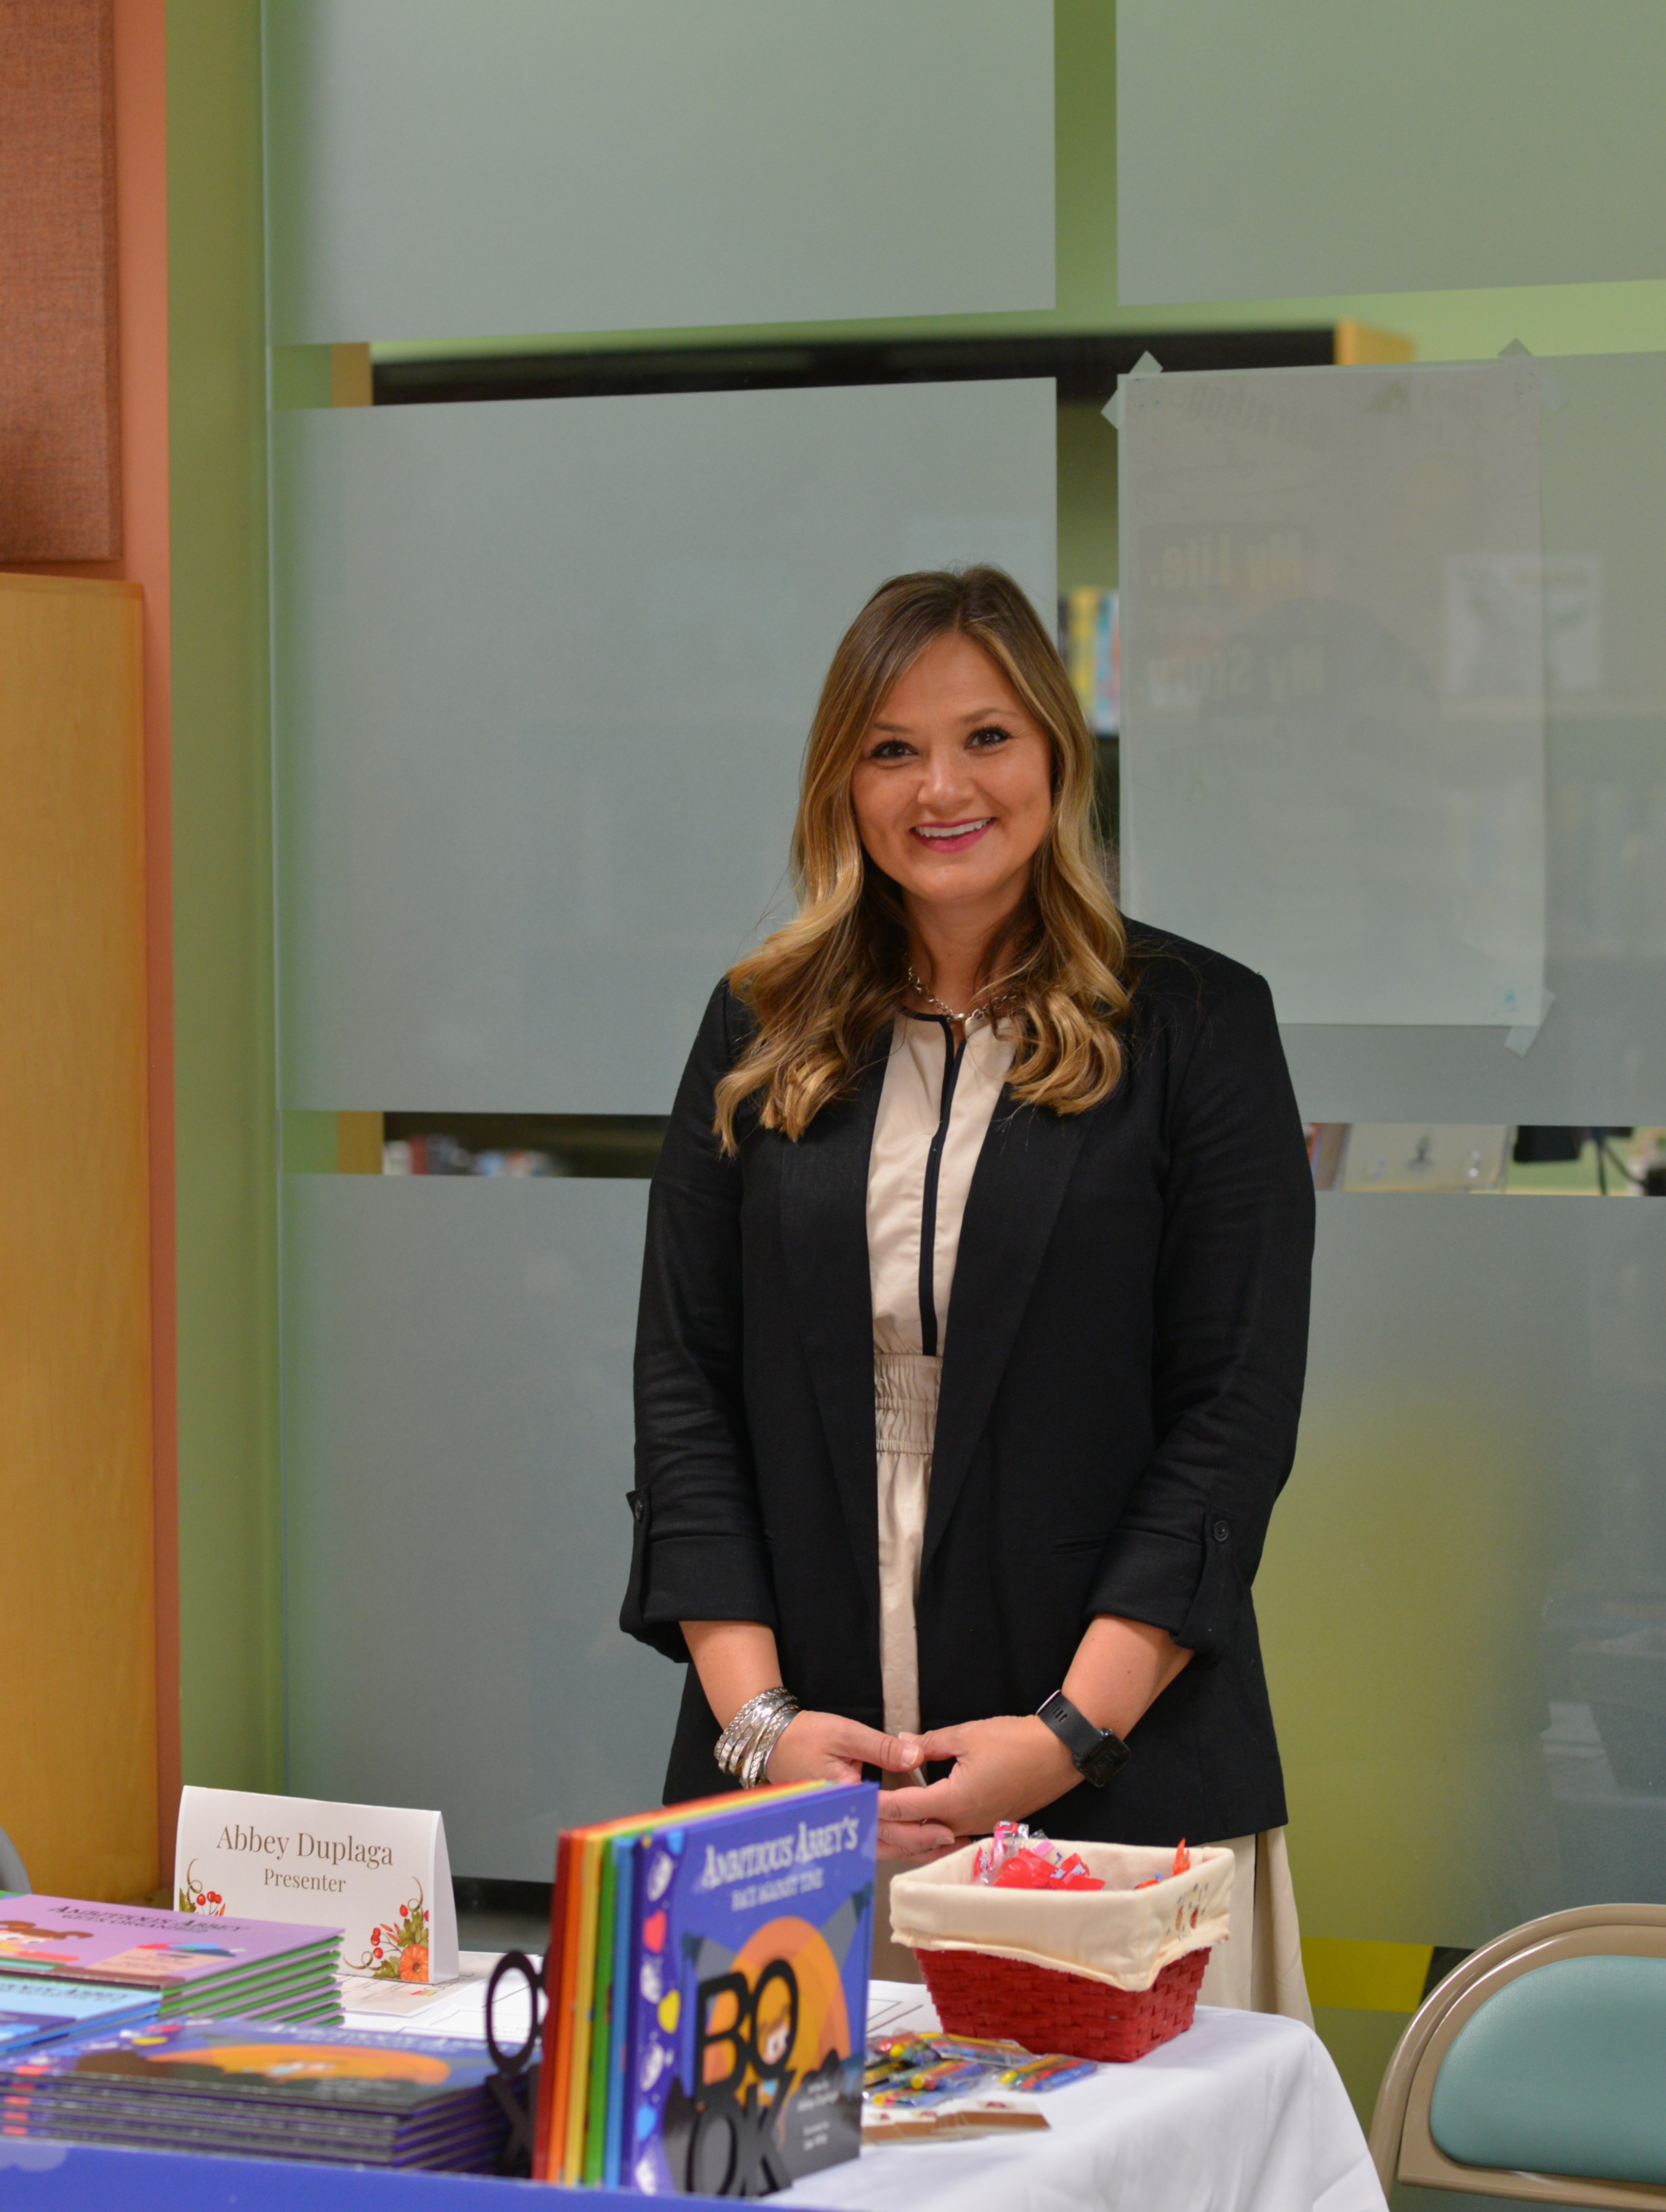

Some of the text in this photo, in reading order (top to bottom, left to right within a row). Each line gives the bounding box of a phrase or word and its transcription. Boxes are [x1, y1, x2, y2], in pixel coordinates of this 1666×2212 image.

[217, 1824, 393, 1869] Abbey Duplaga
[263, 1869, 346, 1893] Presenter
